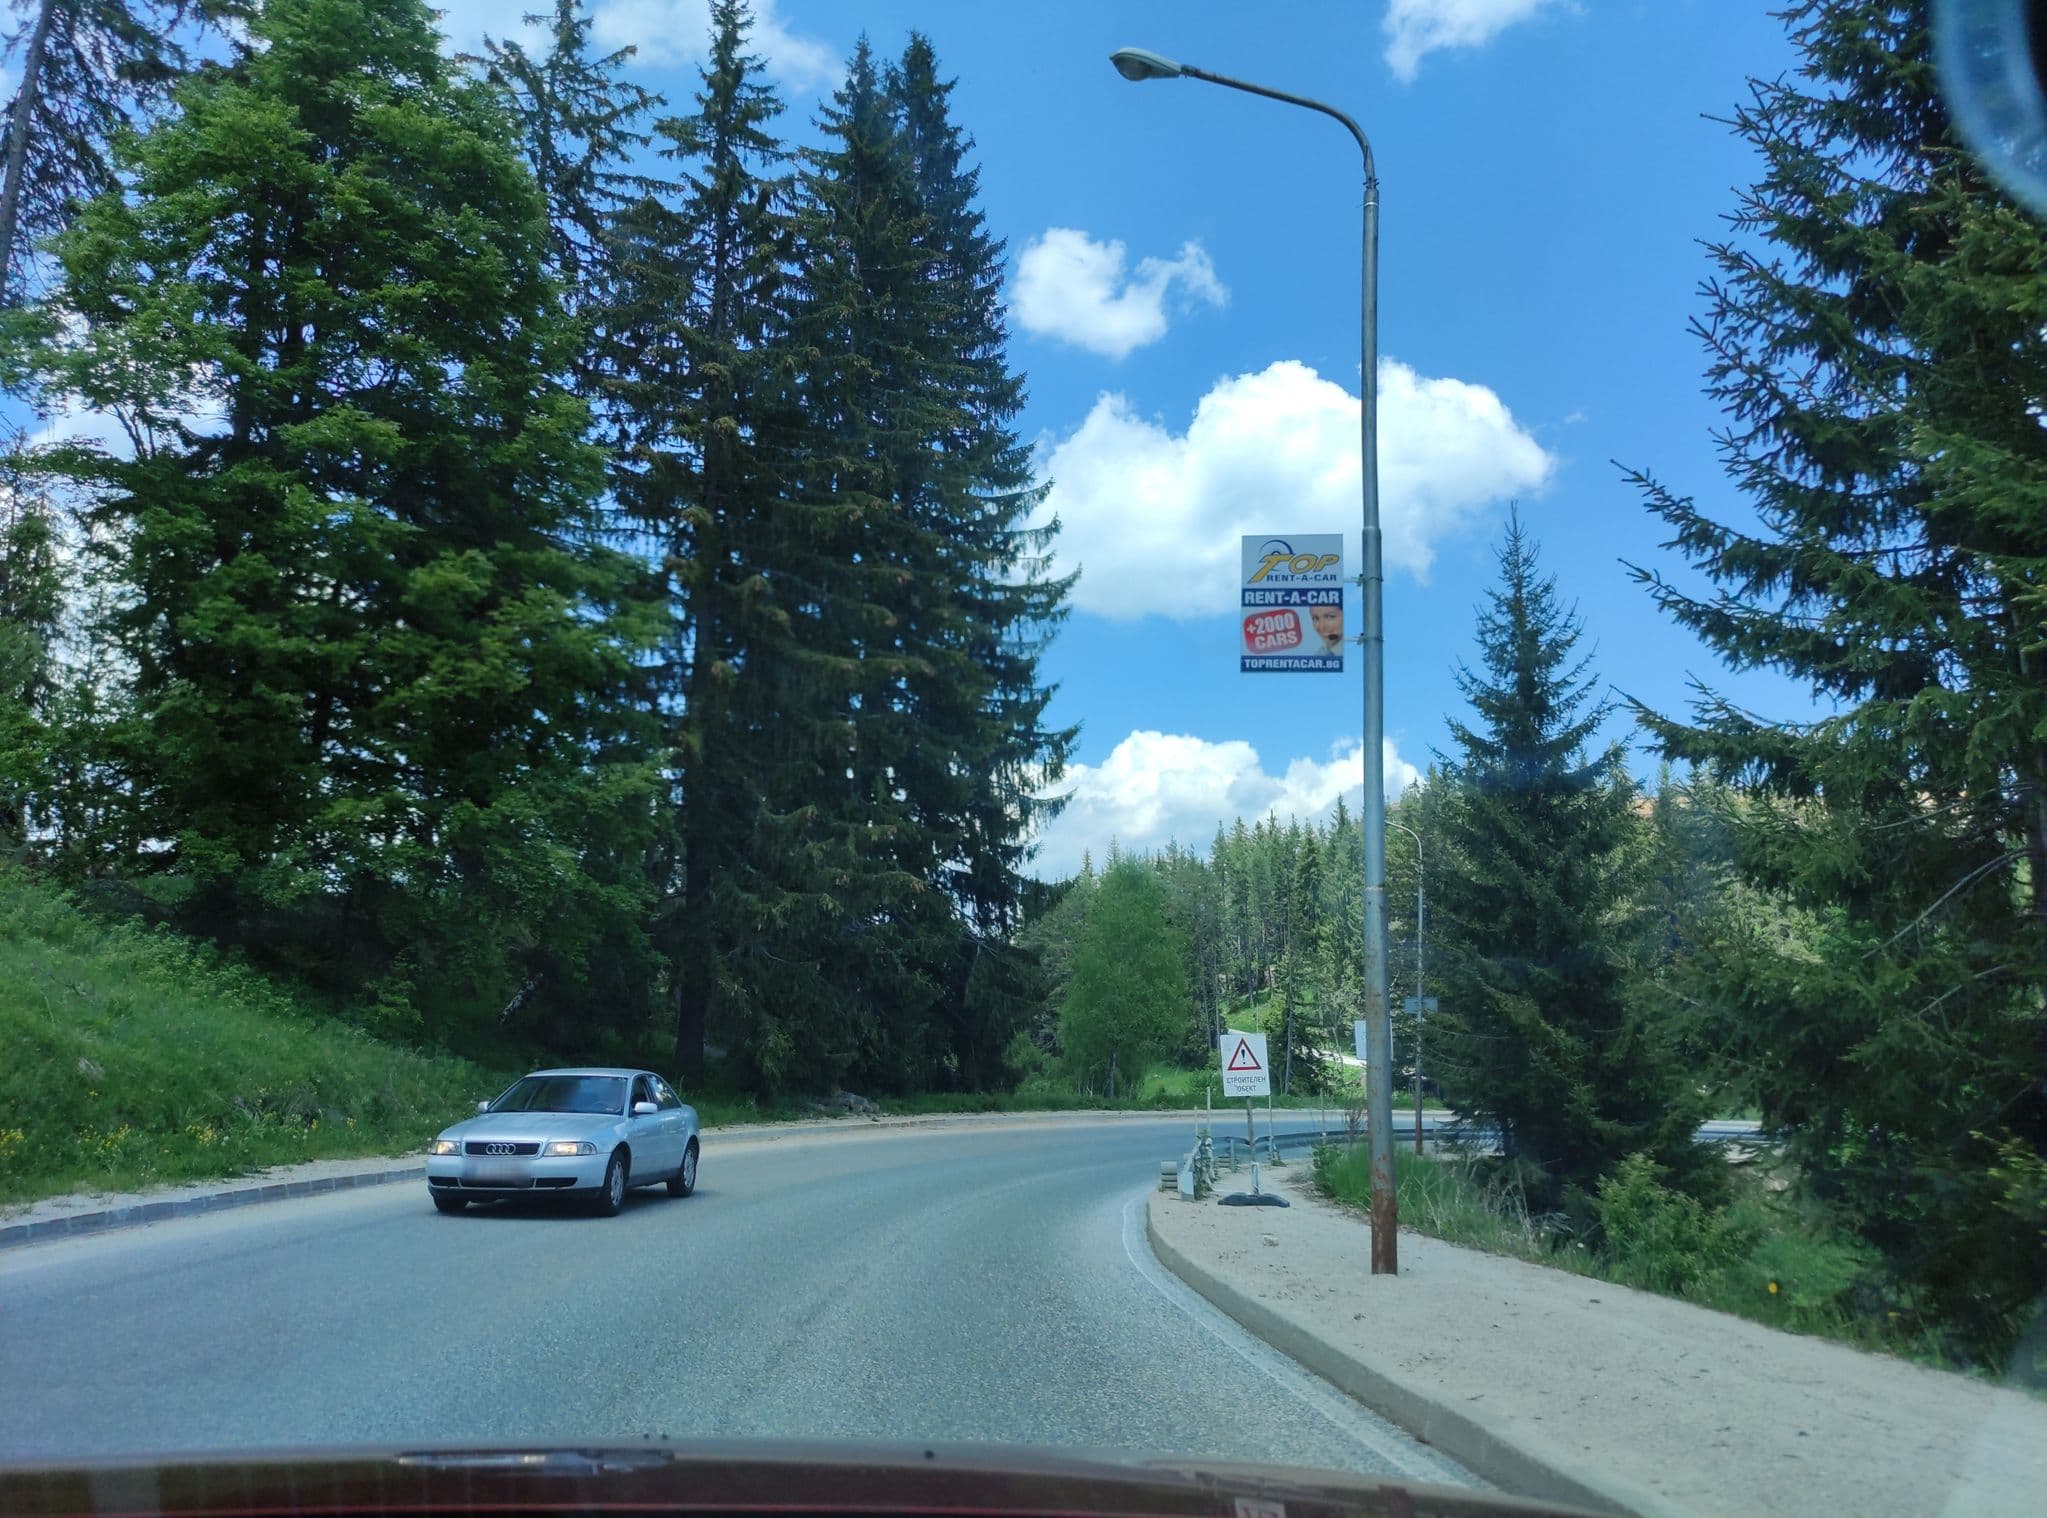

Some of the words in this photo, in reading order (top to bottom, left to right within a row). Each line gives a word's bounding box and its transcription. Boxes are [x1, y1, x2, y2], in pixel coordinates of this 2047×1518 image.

[1247, 554, 1340, 584] TOP
[1266, 574, 1337, 582] RENT-A-CAR
[1245, 591, 1339, 604] RENT-A-CAR
[1247, 612, 1295, 634] +2000
[1254, 631, 1298, 650] CARS
[1244, 658, 1339, 669] TOPRENTACAR.BG
